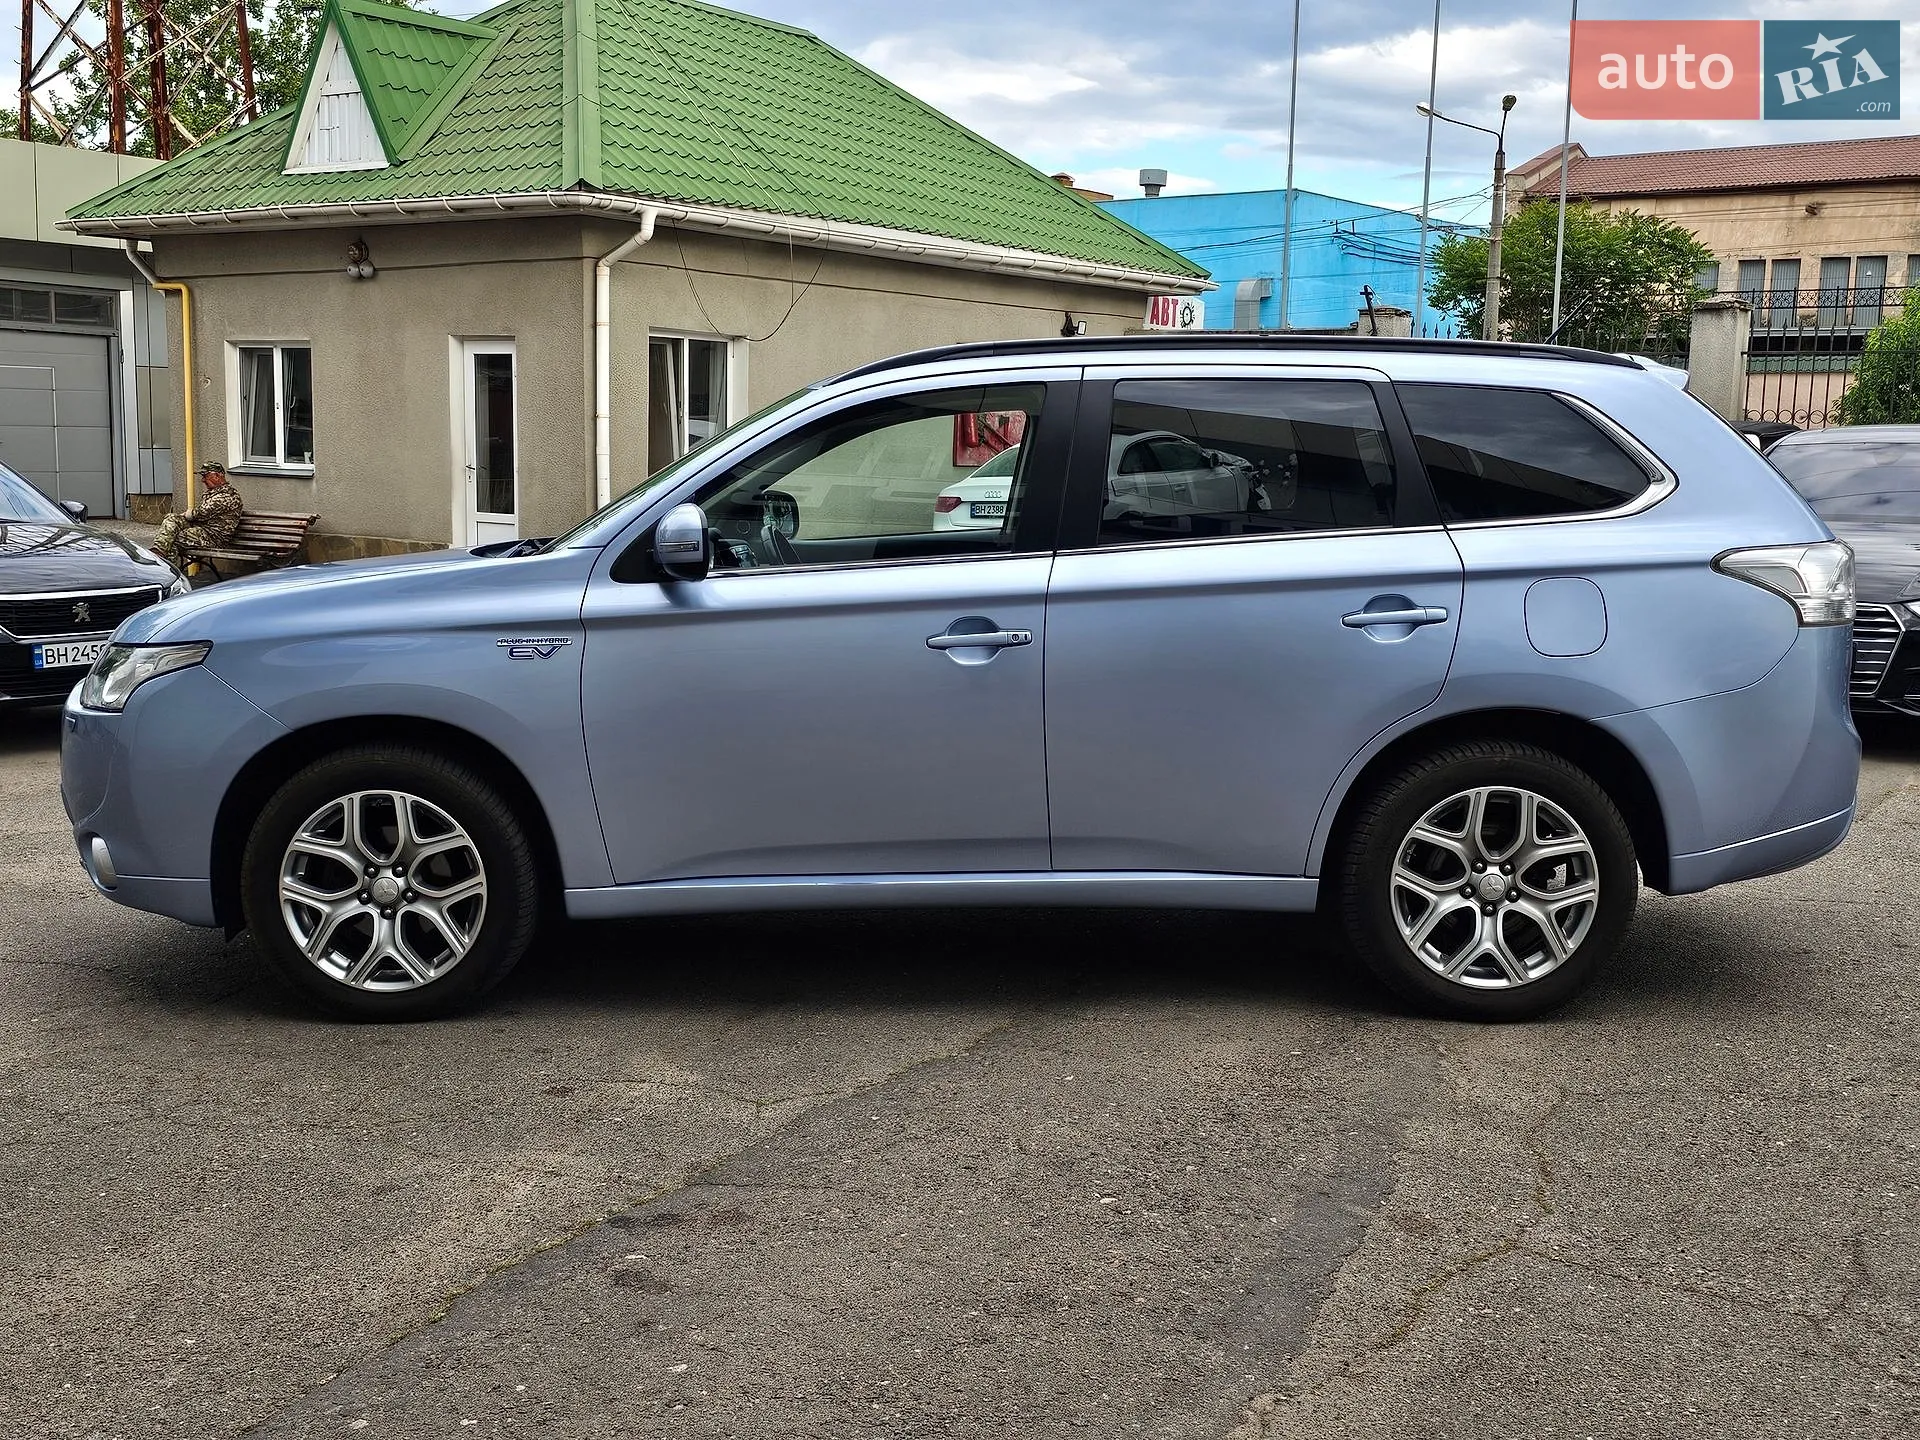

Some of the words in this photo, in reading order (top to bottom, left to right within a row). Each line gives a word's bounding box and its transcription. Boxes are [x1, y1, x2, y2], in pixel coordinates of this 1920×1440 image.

[45, 646, 68, 665] BH
[71, 643, 104, 663] 245
[507, 644, 562, 660] EV
